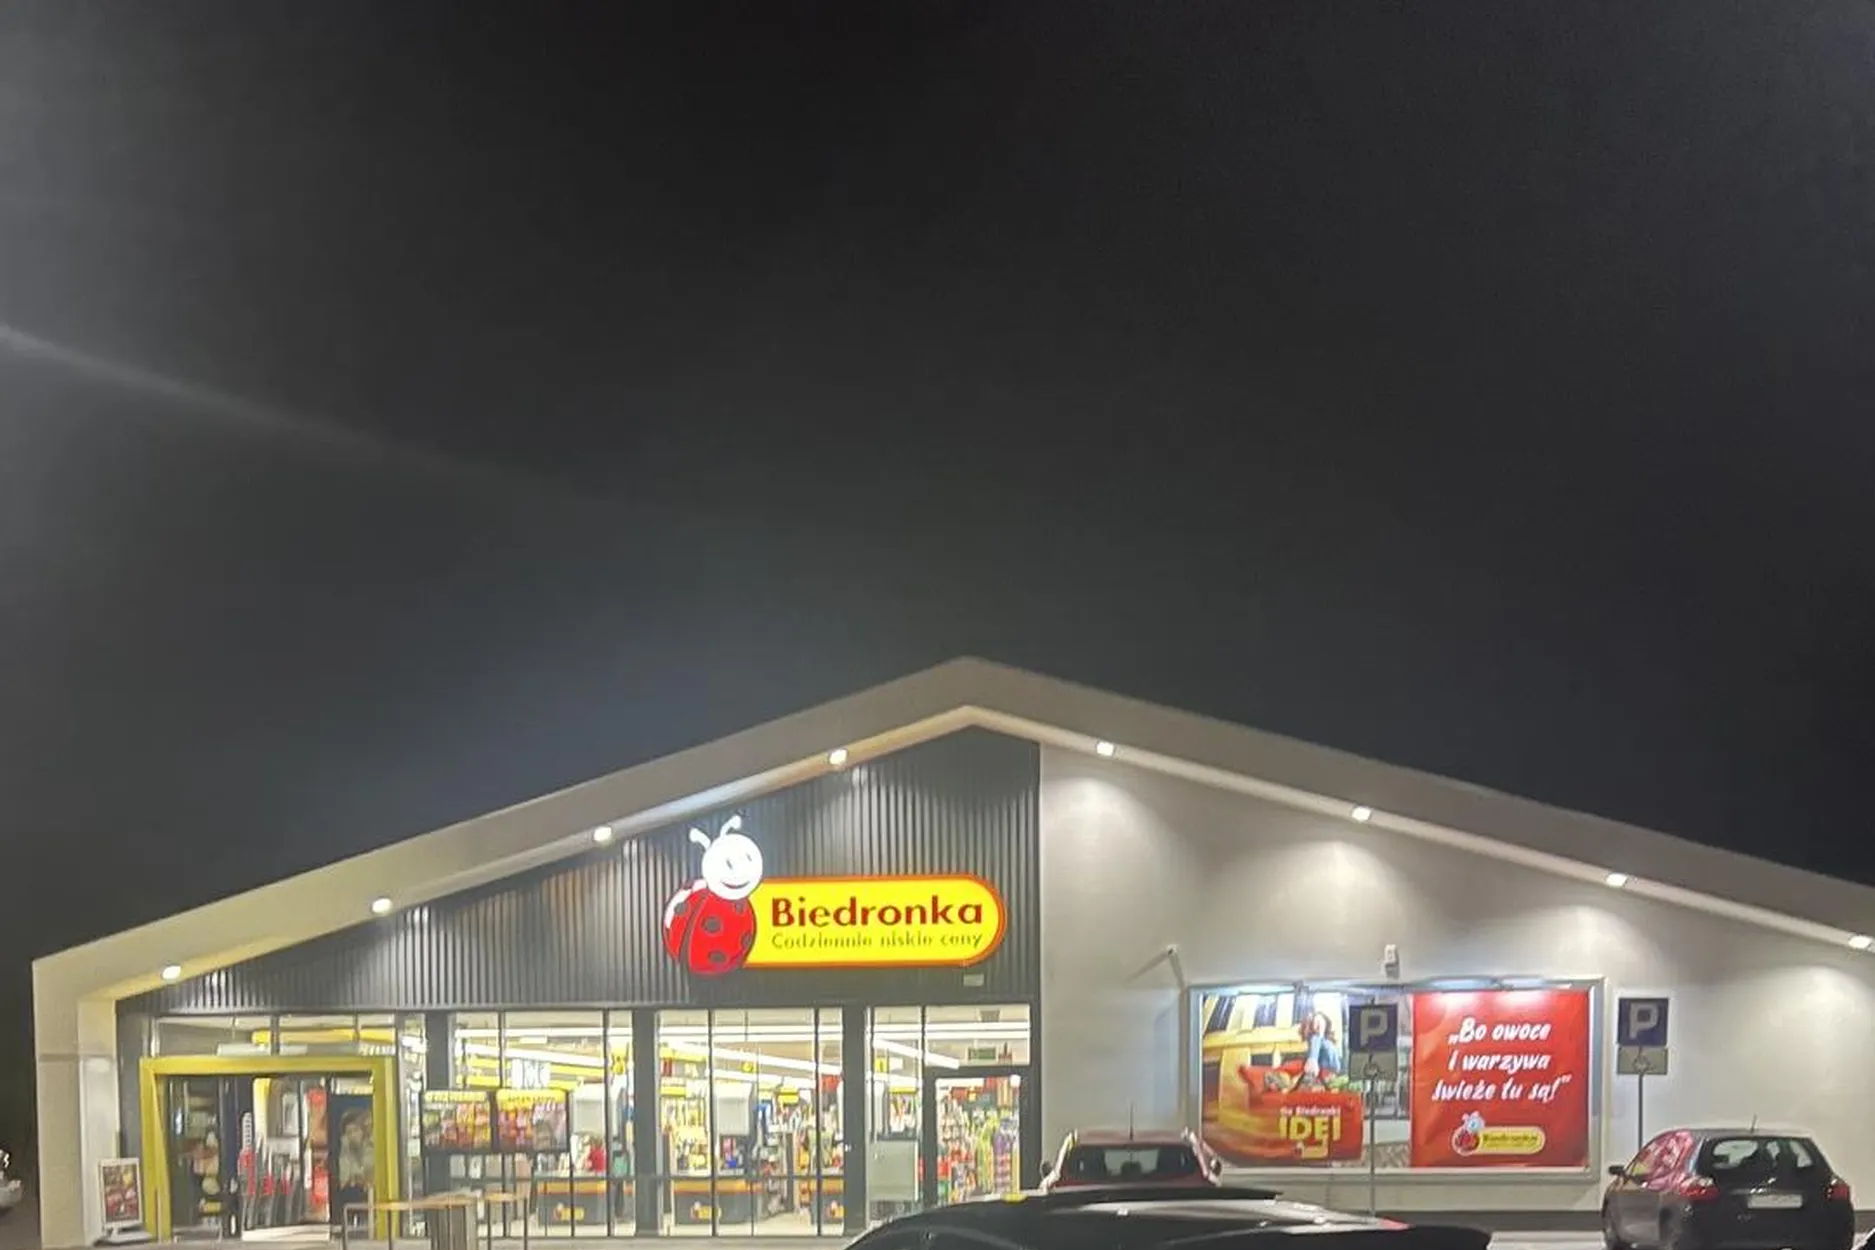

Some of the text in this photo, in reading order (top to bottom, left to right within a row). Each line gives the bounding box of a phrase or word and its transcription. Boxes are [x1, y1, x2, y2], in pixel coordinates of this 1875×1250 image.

[771, 895, 983, 928] Biedronka
[940, 932, 983, 949] ceny
[1361, 1009, 1388, 1047] P
[1491, 1023, 1551, 1041] owoce
[1629, 1003, 1659, 1039] P
[1462, 1053, 1551, 1075] warzywa
[1501, 1077, 1524, 1100] tu
